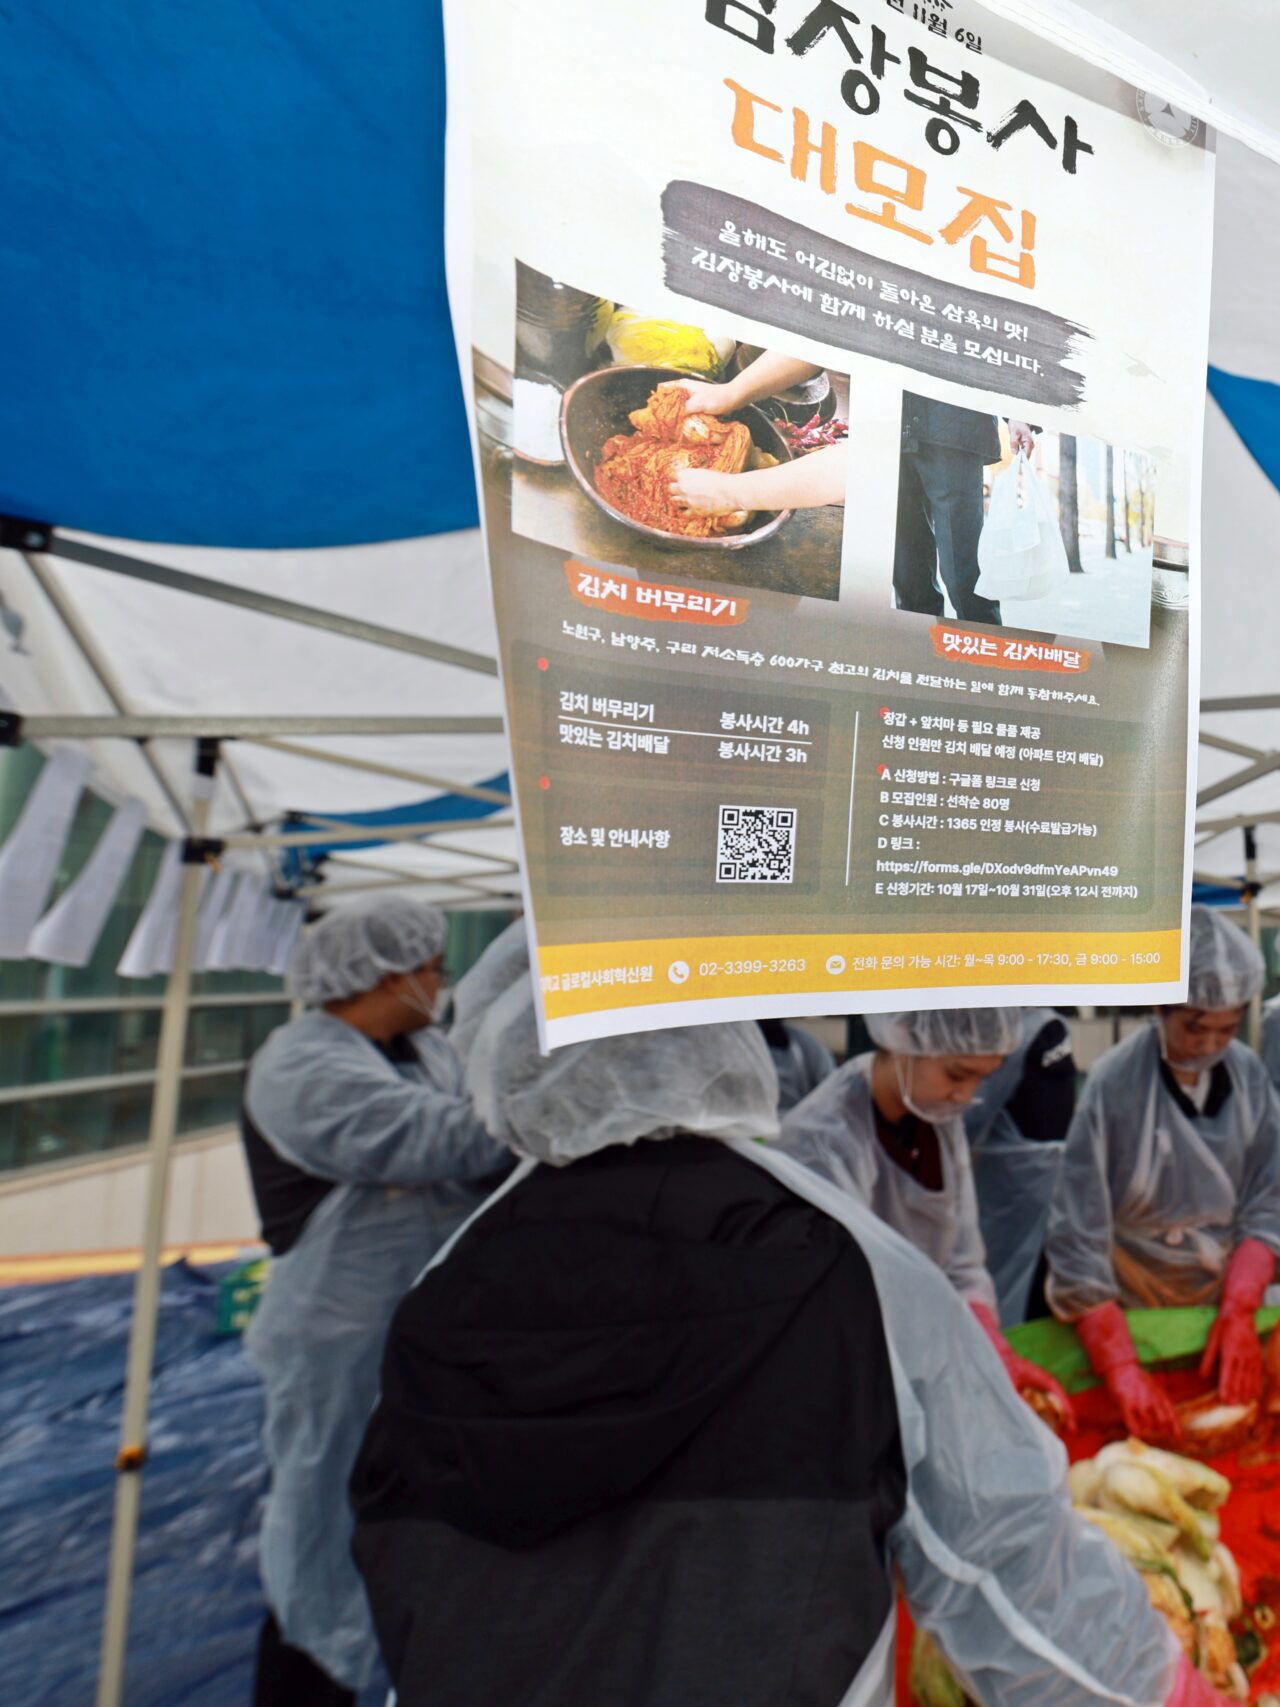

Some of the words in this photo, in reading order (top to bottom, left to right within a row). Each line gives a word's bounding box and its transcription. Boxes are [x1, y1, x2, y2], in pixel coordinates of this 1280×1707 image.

[913, 3, 948, 39] 11월
[955, 28, 982, 55] 6일
[723, 78, 1036, 288] 대모집
[718, 220, 788, 261] 올해도
[795, 251, 873, 290] 어김없이
[879, 280, 936, 315] 돌아온
[941, 303, 998, 332] 삼육의
[1004, 320, 1029, 342] 맛!
[691, 246, 813, 302] 김장봉사에
[820, 293, 866, 321] 함께
[872, 310, 916, 340] 하실
[920, 326, 958, 355] 분을
[963, 339, 1044, 377] 모십니다.
[577, 572, 627, 600] 김치
[636, 586, 736, 617] 버무리기
[562, 620, 605, 644] 노원구,
[611, 630, 660, 653] 남양주,
[665, 640, 697, 656] 구리
[701, 645, 765, 667] 저소득층
[769, 654, 824, 673] 600가구
[828, 661, 869, 677] 최고의
[872, 667, 912, 686] 김치를
[916, 674, 967, 691] 전달하는
[970, 680, 994, 694] 일에
[998, 683, 1024, 696] 함께
[1027, 687, 1101, 706] 동참해주세요.
[943, 632, 997, 657] 맛있는
[1002, 641, 1081, 669] 김치배달
[559, 691, 589, 714] 김치
[591, 697, 655, 723] 버무리기
[720, 712, 784, 734] 봉사시간
[787, 718, 810, 735] 4h
[883, 711, 907, 728] 장갑
[909, 718, 918, 727] +
[921, 715, 954, 732] 앞치마
[957, 719, 968, 733] 등
[971, 720, 993, 736] 필요
[996, 722, 1018, 738] 물품
[1020, 725, 1041, 741] 제공
[559, 723, 603, 748] 맛있는
[606, 730, 670, 754] 김치배달
[718, 741, 782, 763] 봉사시간
[785, 747, 808, 763] 3h
[882, 735, 905, 750] 신청
[907, 737, 942, 753] 인원만
[944, 740, 967, 755] 김치
[969, 742, 992, 757] 배달
[994, 744, 1016, 759] 예정
[1019, 746, 1053, 763] (아파트
[1056, 750, 1076, 765] 단지
[1078, 752, 1104, 767] 배달)
[881, 768, 891, 781] A
[894, 768, 940, 786] 신청방법
[949, 772, 983, 788] 구글폼
[985, 775, 1017, 790] 링크로
[1019, 778, 1041, 792] 신청
[880, 792, 889, 803] B
[891, 791, 937, 807] 모집인원
[946, 795, 980, 810] 선착순
[983, 797, 1010, 811] 80명
[878, 815, 889, 826] C
[891, 814, 937, 829] 봉사시간
[946, 817, 977, 830] 1365
[980, 818, 1001, 832] 인정
[560, 826, 588, 846] 장소
[590, 827, 605, 846] 및
[608, 828, 670, 849] 안내사항
[878, 838, 887, 849] D
[891, 837, 914, 851] 링크
[875, 884, 884, 895] E
[887, 883, 934, 897] 신청기간:
[937, 883, 963, 897] 10월
[965, 884, 1020, 897] 17일~10월
[1022, 884, 1072, 898] 31일(오후
[1074, 885, 1099, 898] 12시
[1101, 885, 1138, 898] 전까지)
[699, 959, 806, 976] 02-3399-3263
[853, 956, 877, 971] 전화
[881, 955, 905, 970] 문의
[909, 955, 930, 969] 가능
[934, 954, 960, 968] 시간:
[964, 953, 995, 967] 월~목
[998, 954, 1024, 966] 9:00
[1036, 953, 1072, 967] 17:30,
[1076, 953, 1087, 967] 금
[1090, 953, 1118, 965] 9:00
[1130, 952, 1160, 964] 15:00
[562, 965, 653, 992] 글로컬사회혁신원
